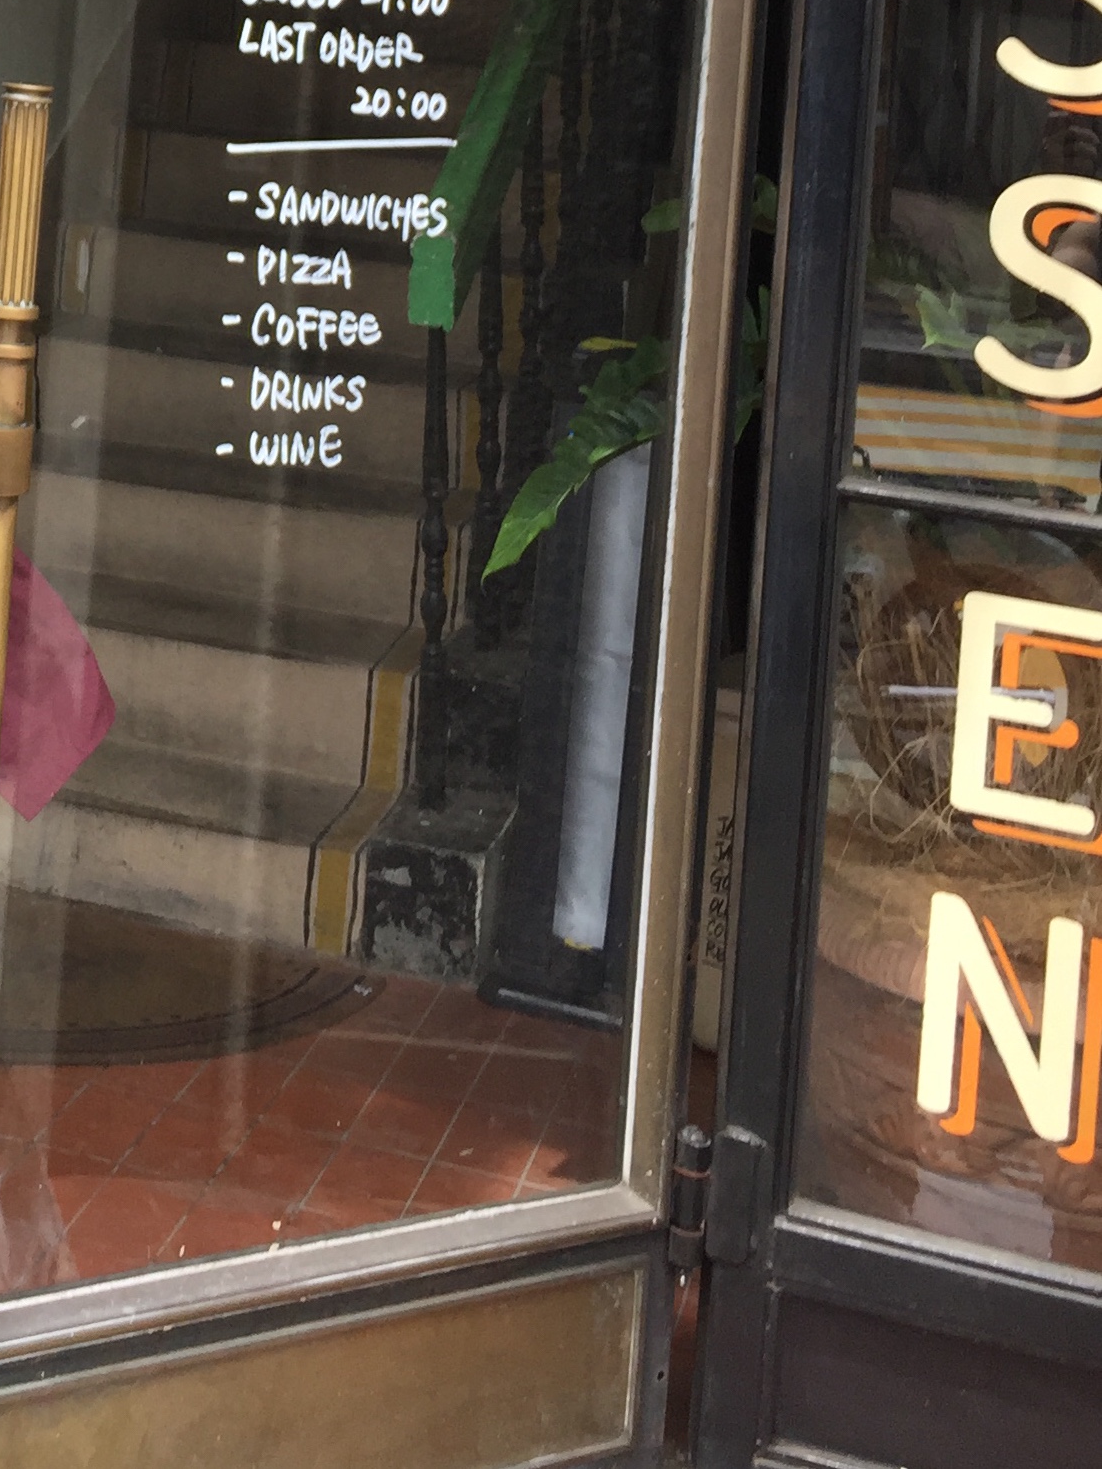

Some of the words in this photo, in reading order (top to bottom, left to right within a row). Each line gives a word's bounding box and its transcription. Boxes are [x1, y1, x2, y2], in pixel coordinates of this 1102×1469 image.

[238, 17, 316, 66] LAST
[319, 26, 424, 73] ORDER
[350, 85, 447, 122] 20:00
[254, 181, 449, 242] SANDWICHES
[257, 248, 352, 290] PIZZA
[250, 302, 383, 351] COFFEE
[250, 366, 367, 413] DRINKS
[248, 423, 343, 468] WINE
